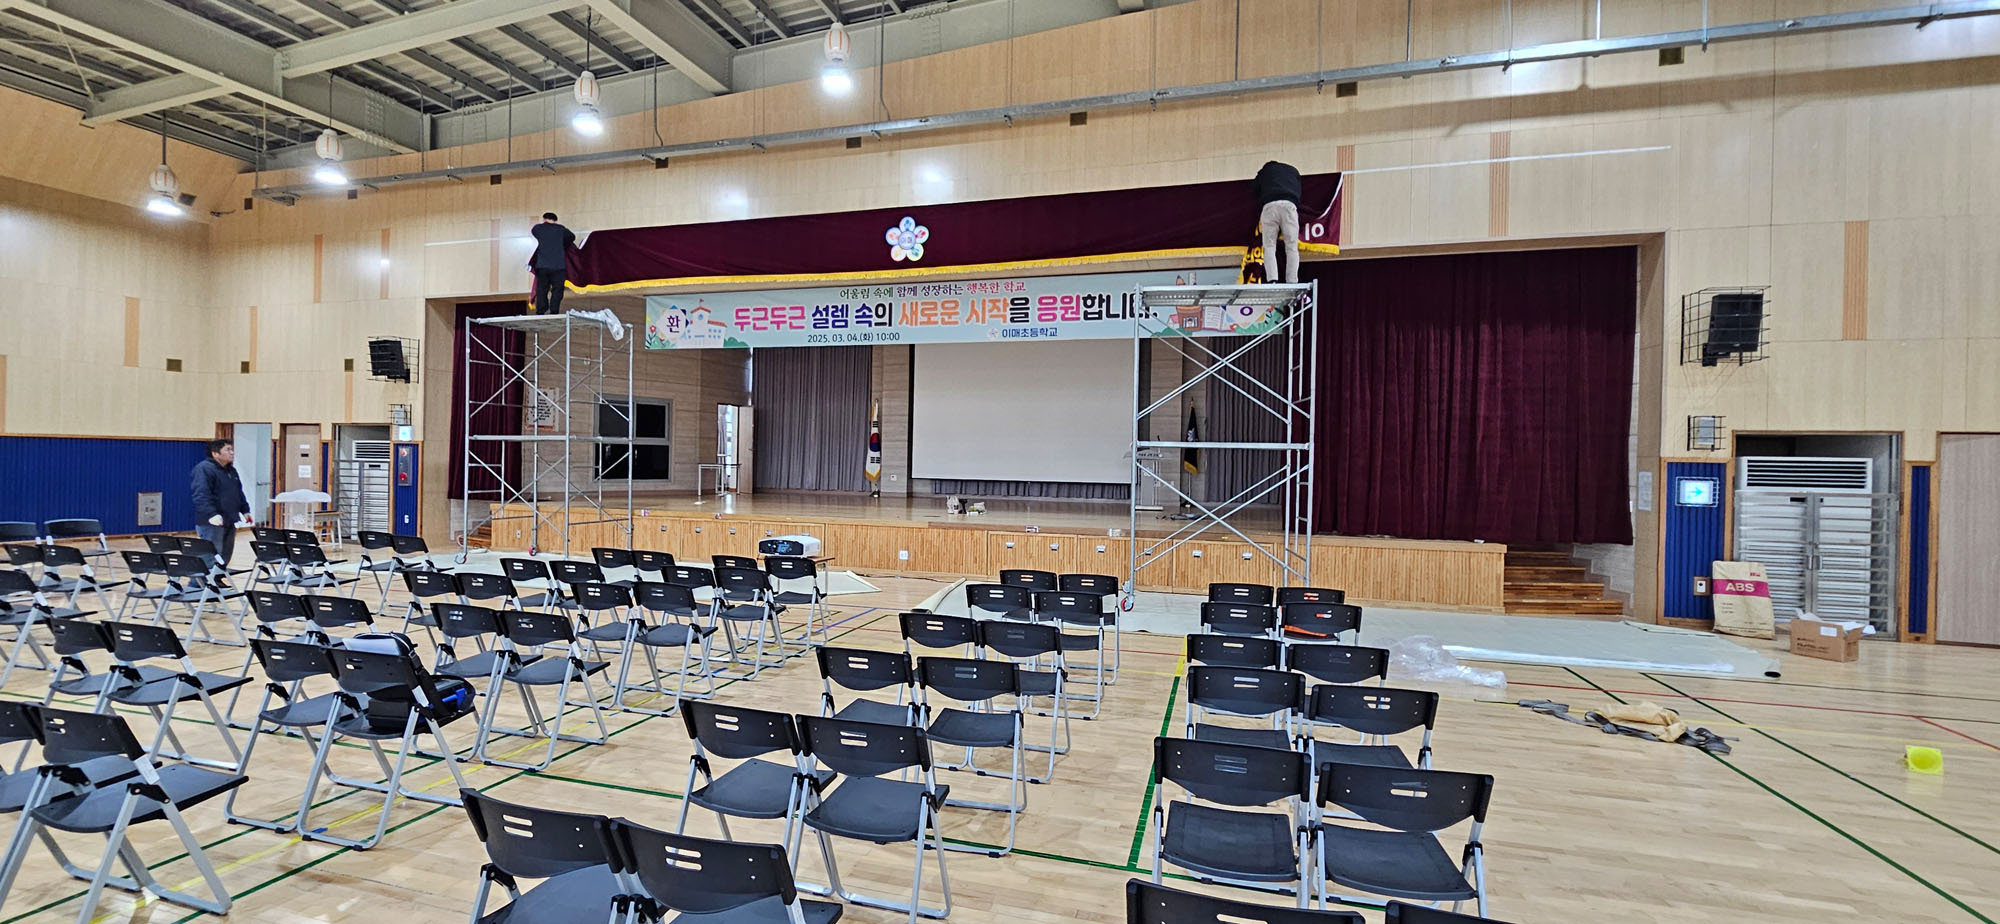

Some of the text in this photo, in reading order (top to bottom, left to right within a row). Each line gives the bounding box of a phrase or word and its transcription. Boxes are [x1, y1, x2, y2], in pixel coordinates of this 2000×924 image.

[839, 280, 1026, 299] 어울림 속에 함께 성장하는 행복한 학교
[734, 306, 805, 330] 두근두근
[811, 303, 850, 330] 설렘
[854, 301, 894, 328] 속의
[898, 299, 960, 327] 새로운
[965, 297, 1030, 324] 시작을
[666, 314, 681, 333] 환
[807, 332, 901, 343] 2025. 03. 04.(화) 10:00
[1001, 327, 1058, 338] 이매초등학교
[1725, 582, 1755, 593] ABS
